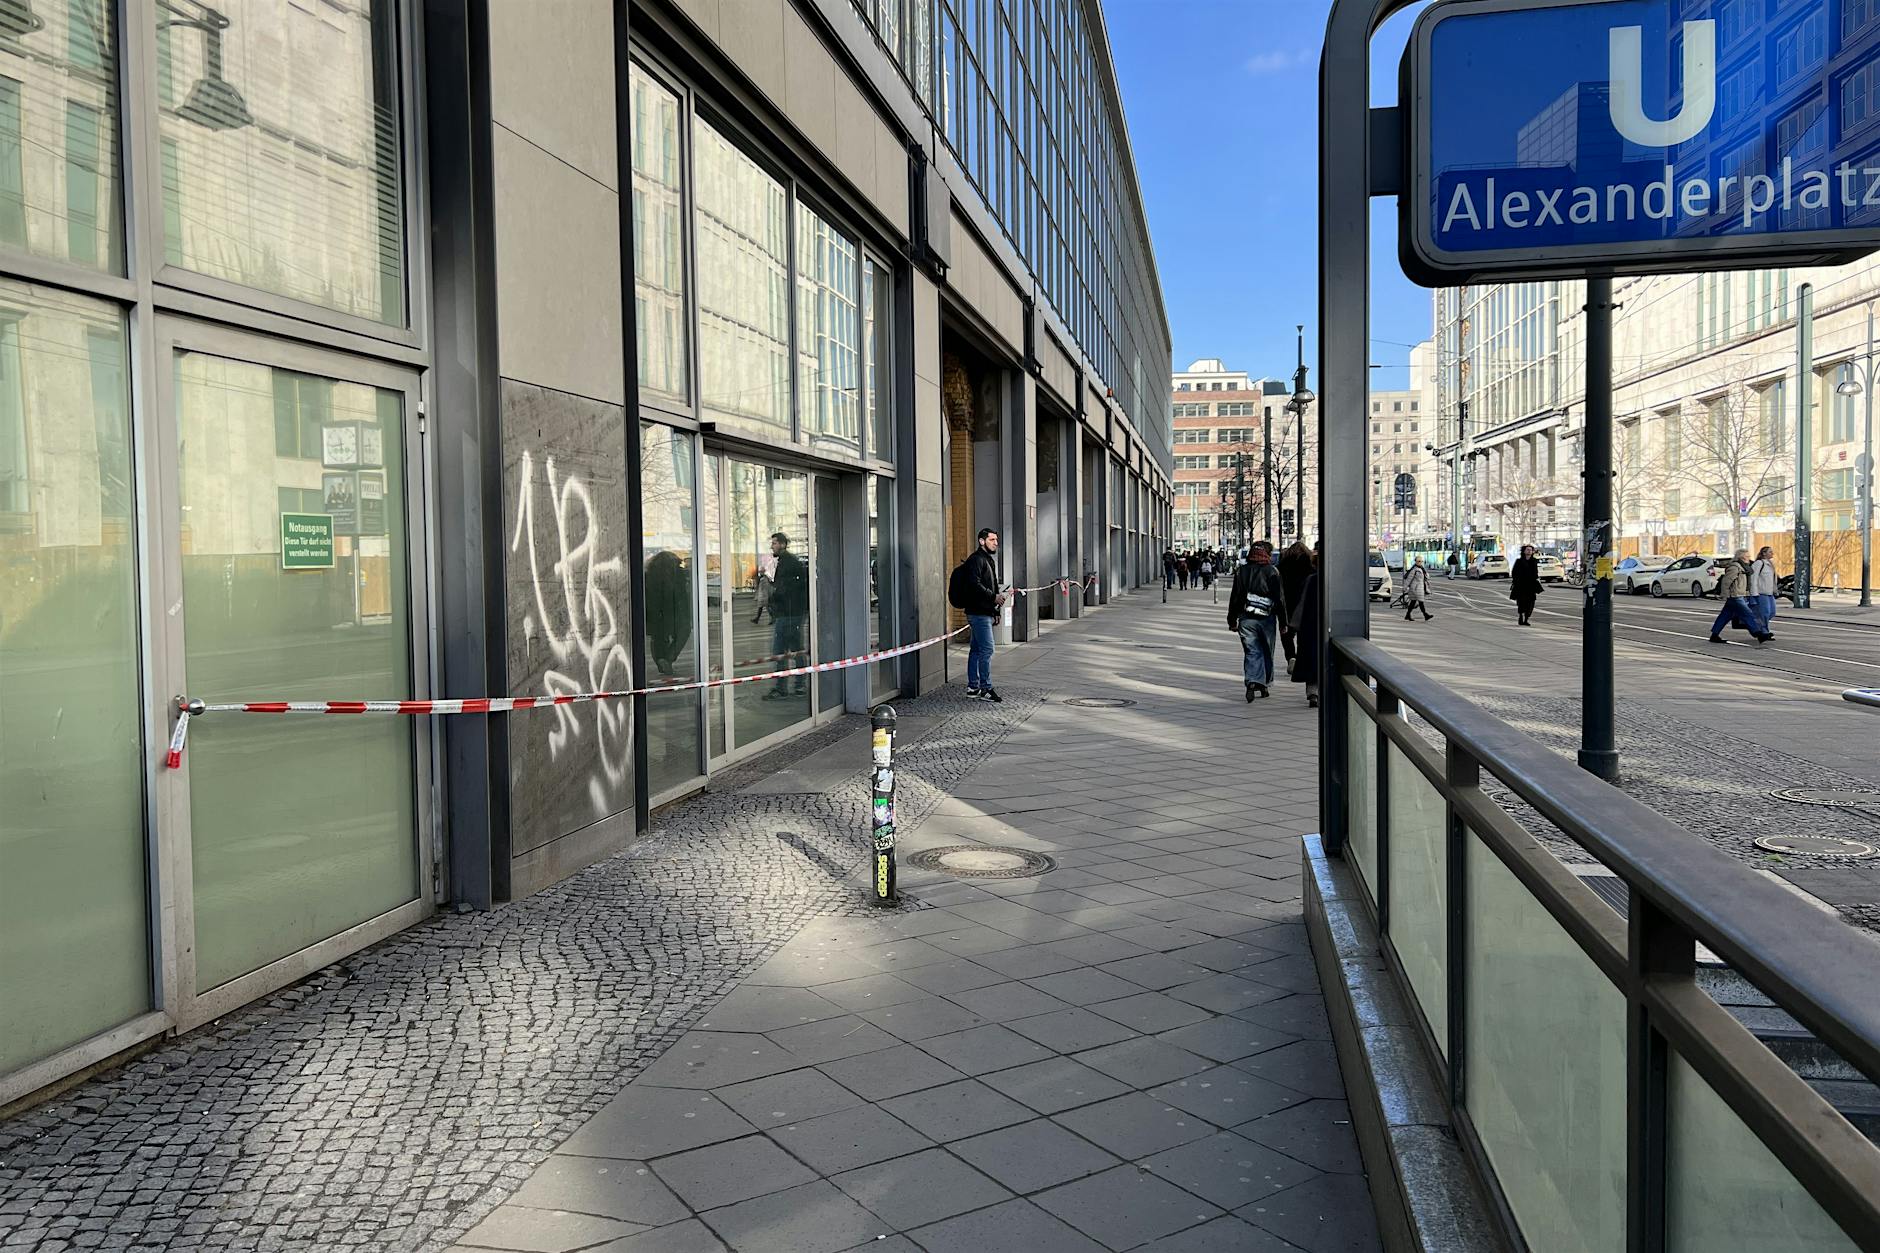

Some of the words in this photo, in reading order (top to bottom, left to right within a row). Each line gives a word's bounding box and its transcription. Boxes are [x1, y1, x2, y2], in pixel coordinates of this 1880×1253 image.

[1608, 19, 1716, 148] U
[1442, 156, 1880, 234] Alexanderplatz
[288, 522, 328, 536] Notausgang
[284, 536, 300, 545] Diese
[300, 536, 308, 545] Tür
[309, 537, 319, 546] darf
[289, 548, 310, 557] verstellt
